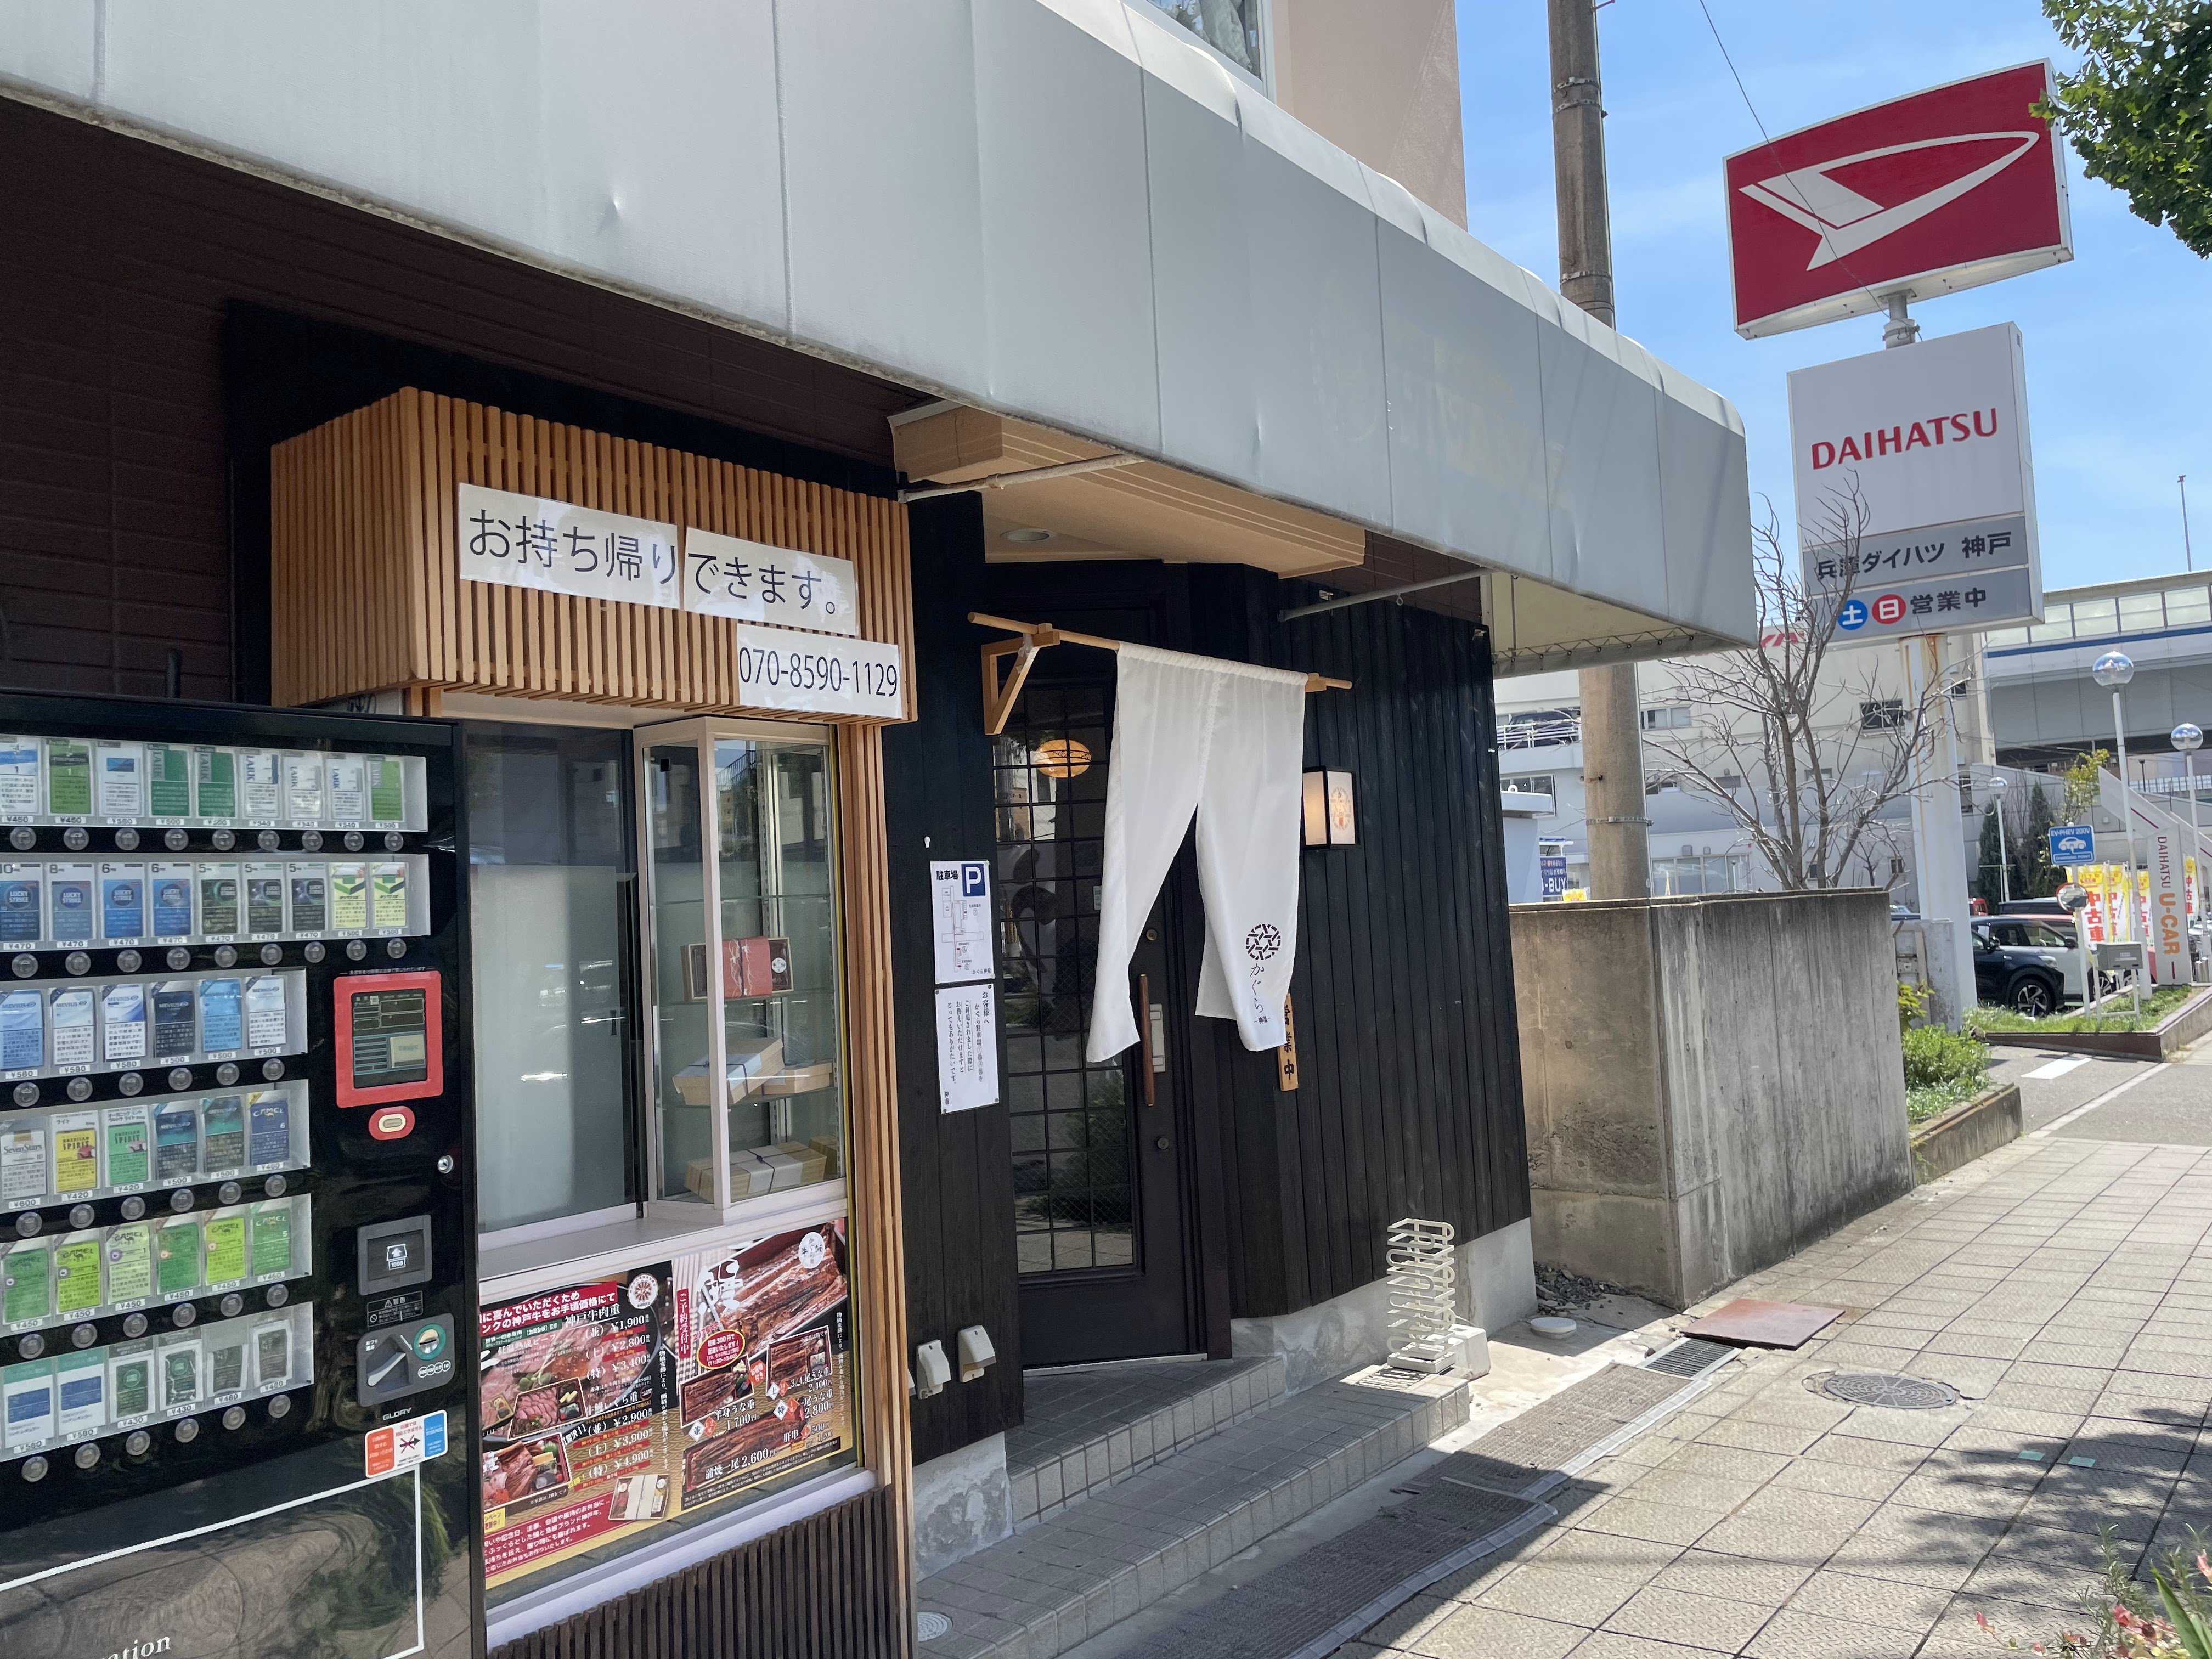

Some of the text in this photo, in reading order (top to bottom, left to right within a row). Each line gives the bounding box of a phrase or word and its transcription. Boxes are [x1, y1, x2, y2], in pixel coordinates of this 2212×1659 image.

[1812, 408, 1998, 470] DAIHATSU
[1961, 531, 2012, 558] 神戸
[1842, 587, 1987, 625] 土 日 営業中
[738, 646, 899, 698] 070-8590-1129
[2157, 836, 2172, 889] DAIHATSU
[936, 866, 982, 894] 駐車場 P
[1542, 877, 1566, 893] -BUY
[2085, 890, 2106, 942] 中古車
[2158, 892, 2181, 955] U-CAR
[1250, 962, 1265, 1014] かぐら
[981, 991, 990, 1024] お客様へ
[253, 1107, 284, 1117] CAMEL
[63, 1141, 89, 1150] SPIRIT
[256, 1216, 287, 1227] CAMEL
[63, 1248, 94, 1258] CAMEL
[169, 1291, 190, 1299] ¥450
[69, 1310, 91, 1318] ¥450
[121, 1301, 142, 1309] ¥450
[479, 1290, 580, 1324] に喜んでいただくため
[481, 1292, 616, 1334] ンクの神戸牛をお手頃価格にて
[16, 1320, 39, 1328] ¥450
[563, 1304, 620, 1328] 神戸牛肉重
[611, 1315, 645, 1332] ¥1,900
[679, 1293, 690, 1356] ご予約受付中
[611, 1334, 646, 1352] ¥2,800
[612, 1355, 647, 1373] ¥3,400
[264, 1381, 284, 1390] ¥480
[218, 1393, 238, 1403] ¥480
[172, 1406, 191, 1414] ¥430
[382, 1407, 412, 1421] GLORY
[613, 1409, 648, 1428] ¥2,900
[714, 1398, 755, 1421] 半身うな重
[122, 1417, 143, 1426] ¥430
[72, 1430, 93, 1439] ¥580
[614, 1430, 648, 1449] ¥3,900
[614, 1452, 649, 1470] ¥4,900
[705, 1464, 724, 1480] 蒲焼
[742, 1448, 776, 1470] 2,600円
[102, 1637, 171, 1659] tion
